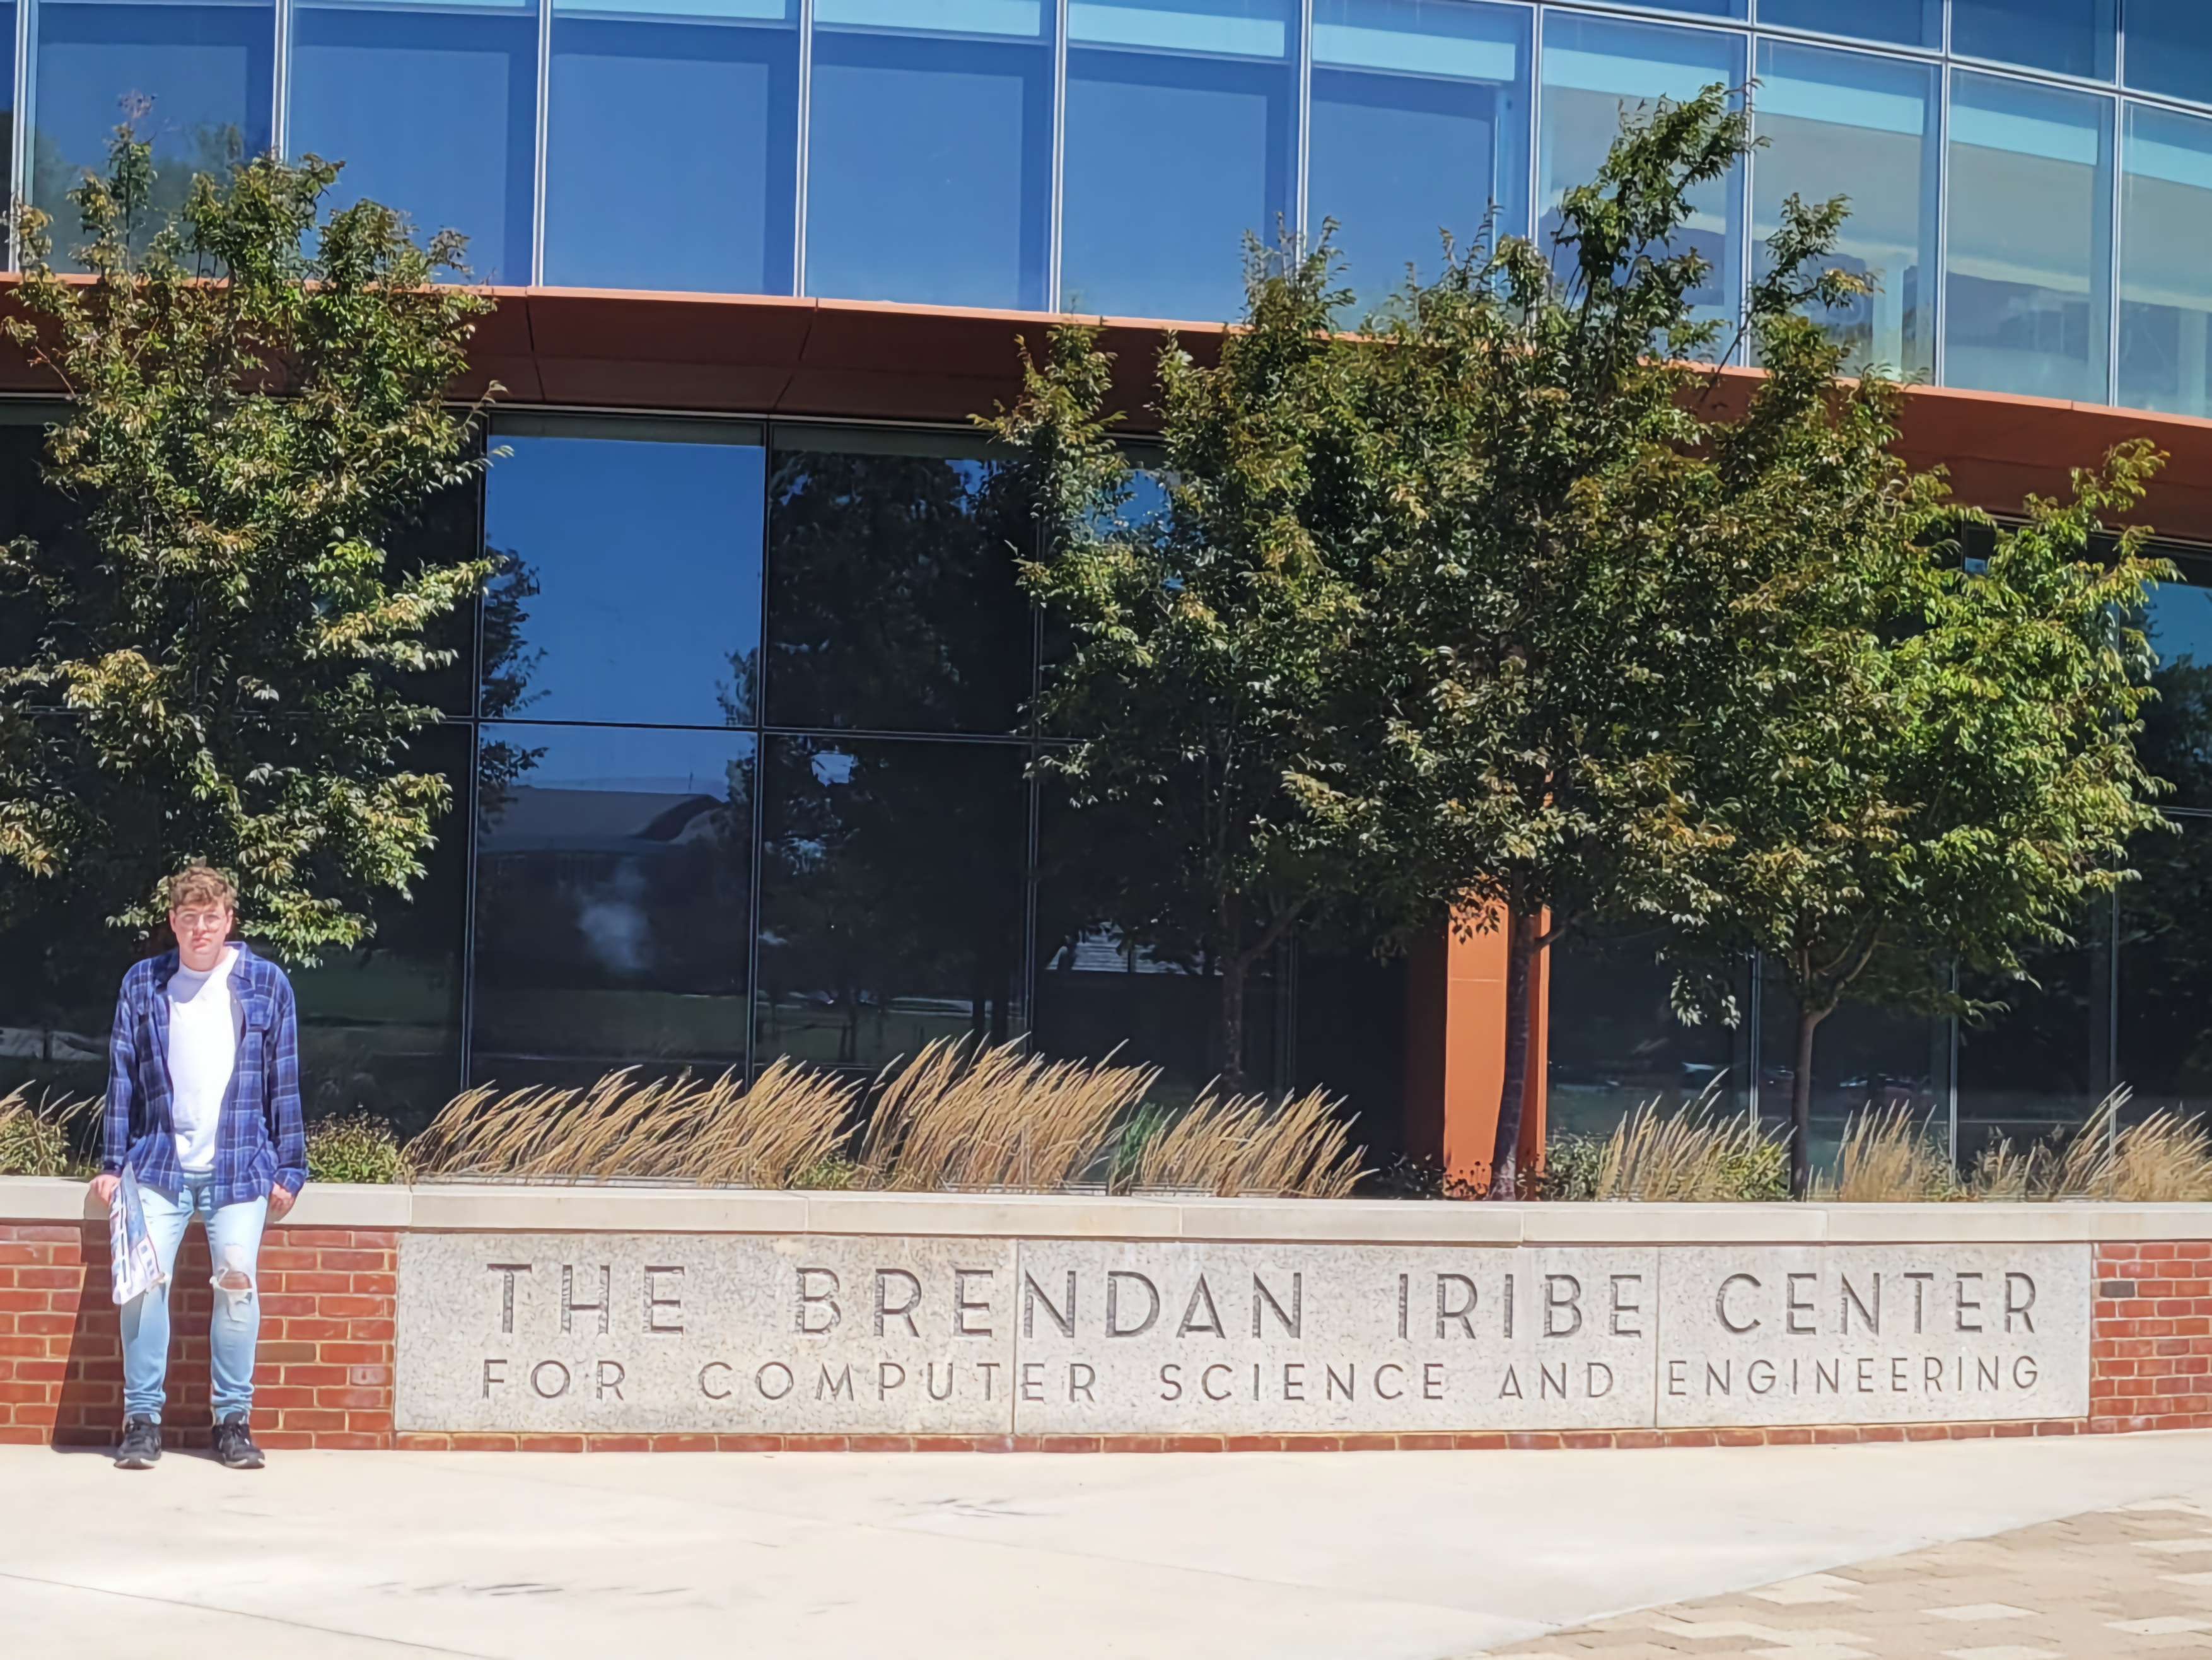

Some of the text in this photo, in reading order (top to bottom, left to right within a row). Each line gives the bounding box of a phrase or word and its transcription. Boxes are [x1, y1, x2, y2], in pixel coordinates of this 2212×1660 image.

[487, 1263, 2037, 1340] THE BRENDAN IRIBE CENTER
[482, 1355, 2039, 1403] FOR COMPUTER SCIENCE AND ENGINEERING
